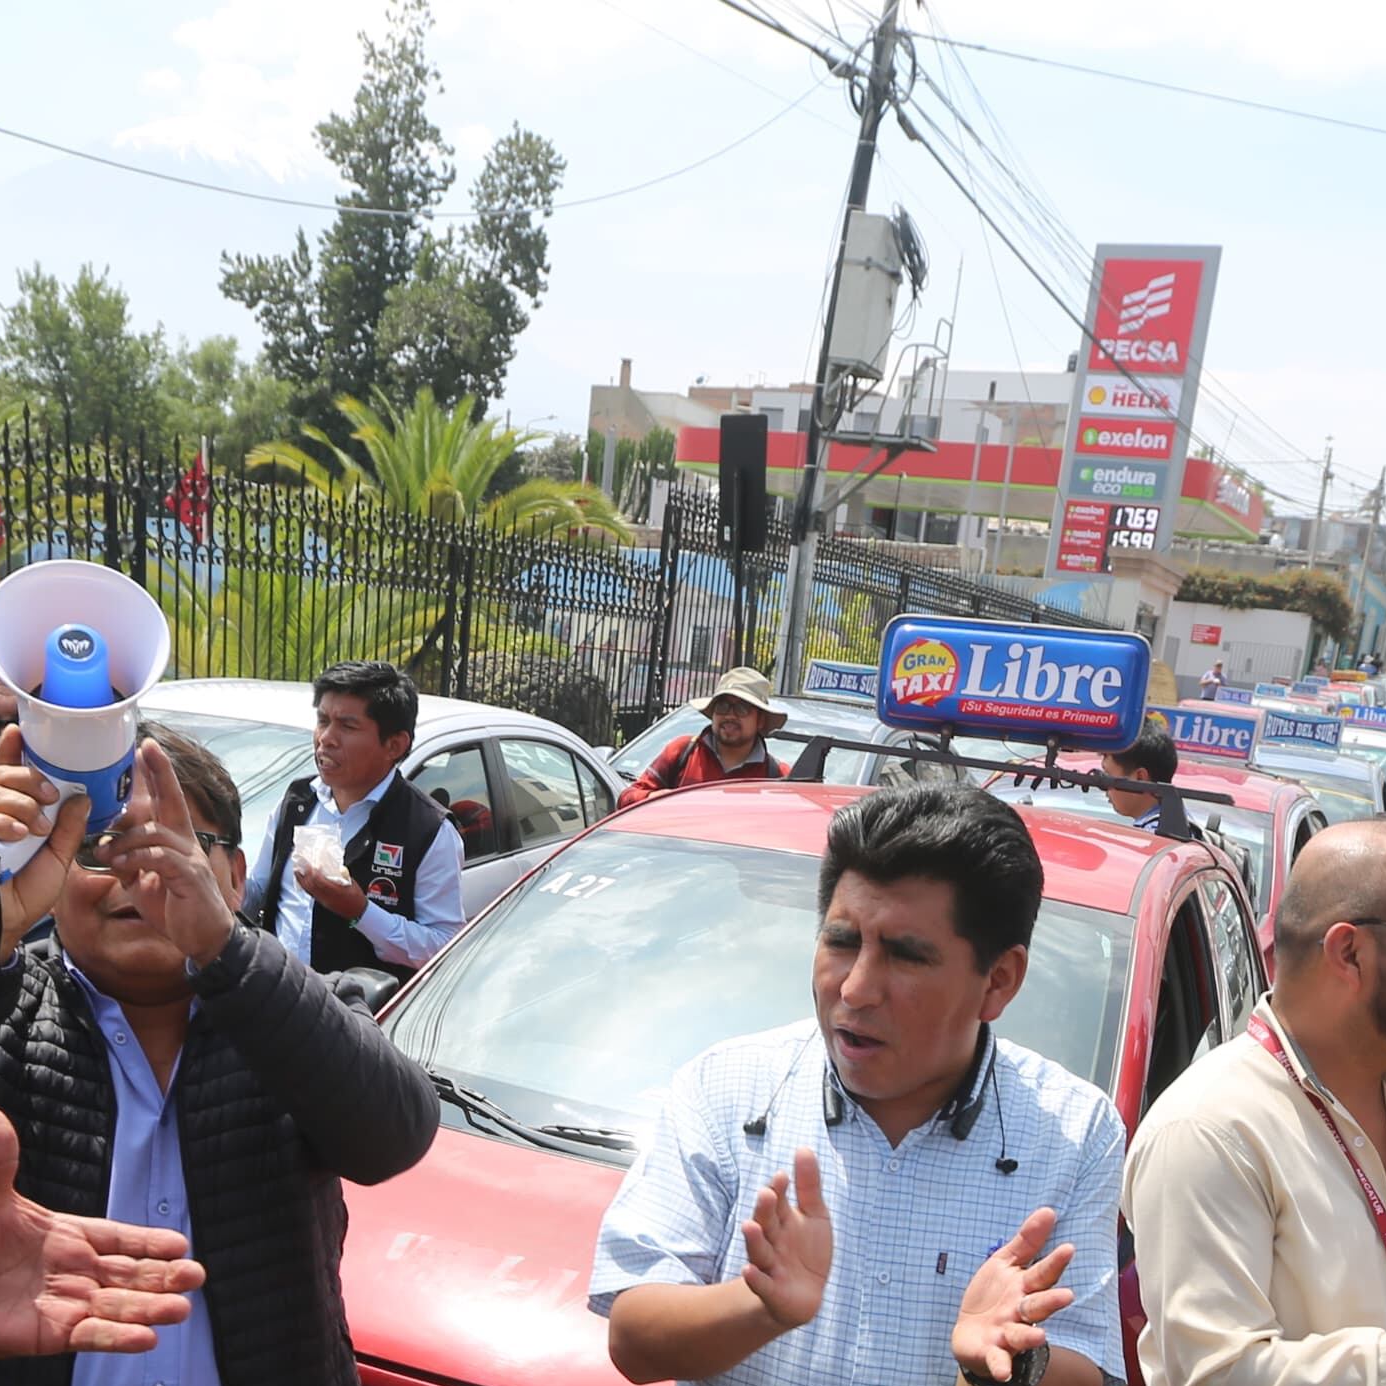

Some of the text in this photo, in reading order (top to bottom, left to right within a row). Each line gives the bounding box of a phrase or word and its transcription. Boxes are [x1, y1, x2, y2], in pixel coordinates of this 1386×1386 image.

[1097, 338, 1179, 363] PECSA
[1097, 427, 1168, 449] exelon
[1092, 466, 1156, 486] endura
[1092, 482, 1121, 495] eco
[903, 652, 947, 671] GRAN
[808, 665, 840, 689] RUTAS
[839, 673, 859, 691] DEL
[960, 642, 1123, 709] Libre
[985, 702, 1043, 721] Seguridad
[1045, 709, 1060, 720] es
[1063, 709, 1114, 726] Primero!
[1264, 714, 1294, 737] RUTAS
[1295, 720, 1315, 737] DEL
[1172, 714, 1251, 750] Libre
[538, 872, 617, 899] A 27
[1355, 1168, 1385, 1215] MEGATUR
